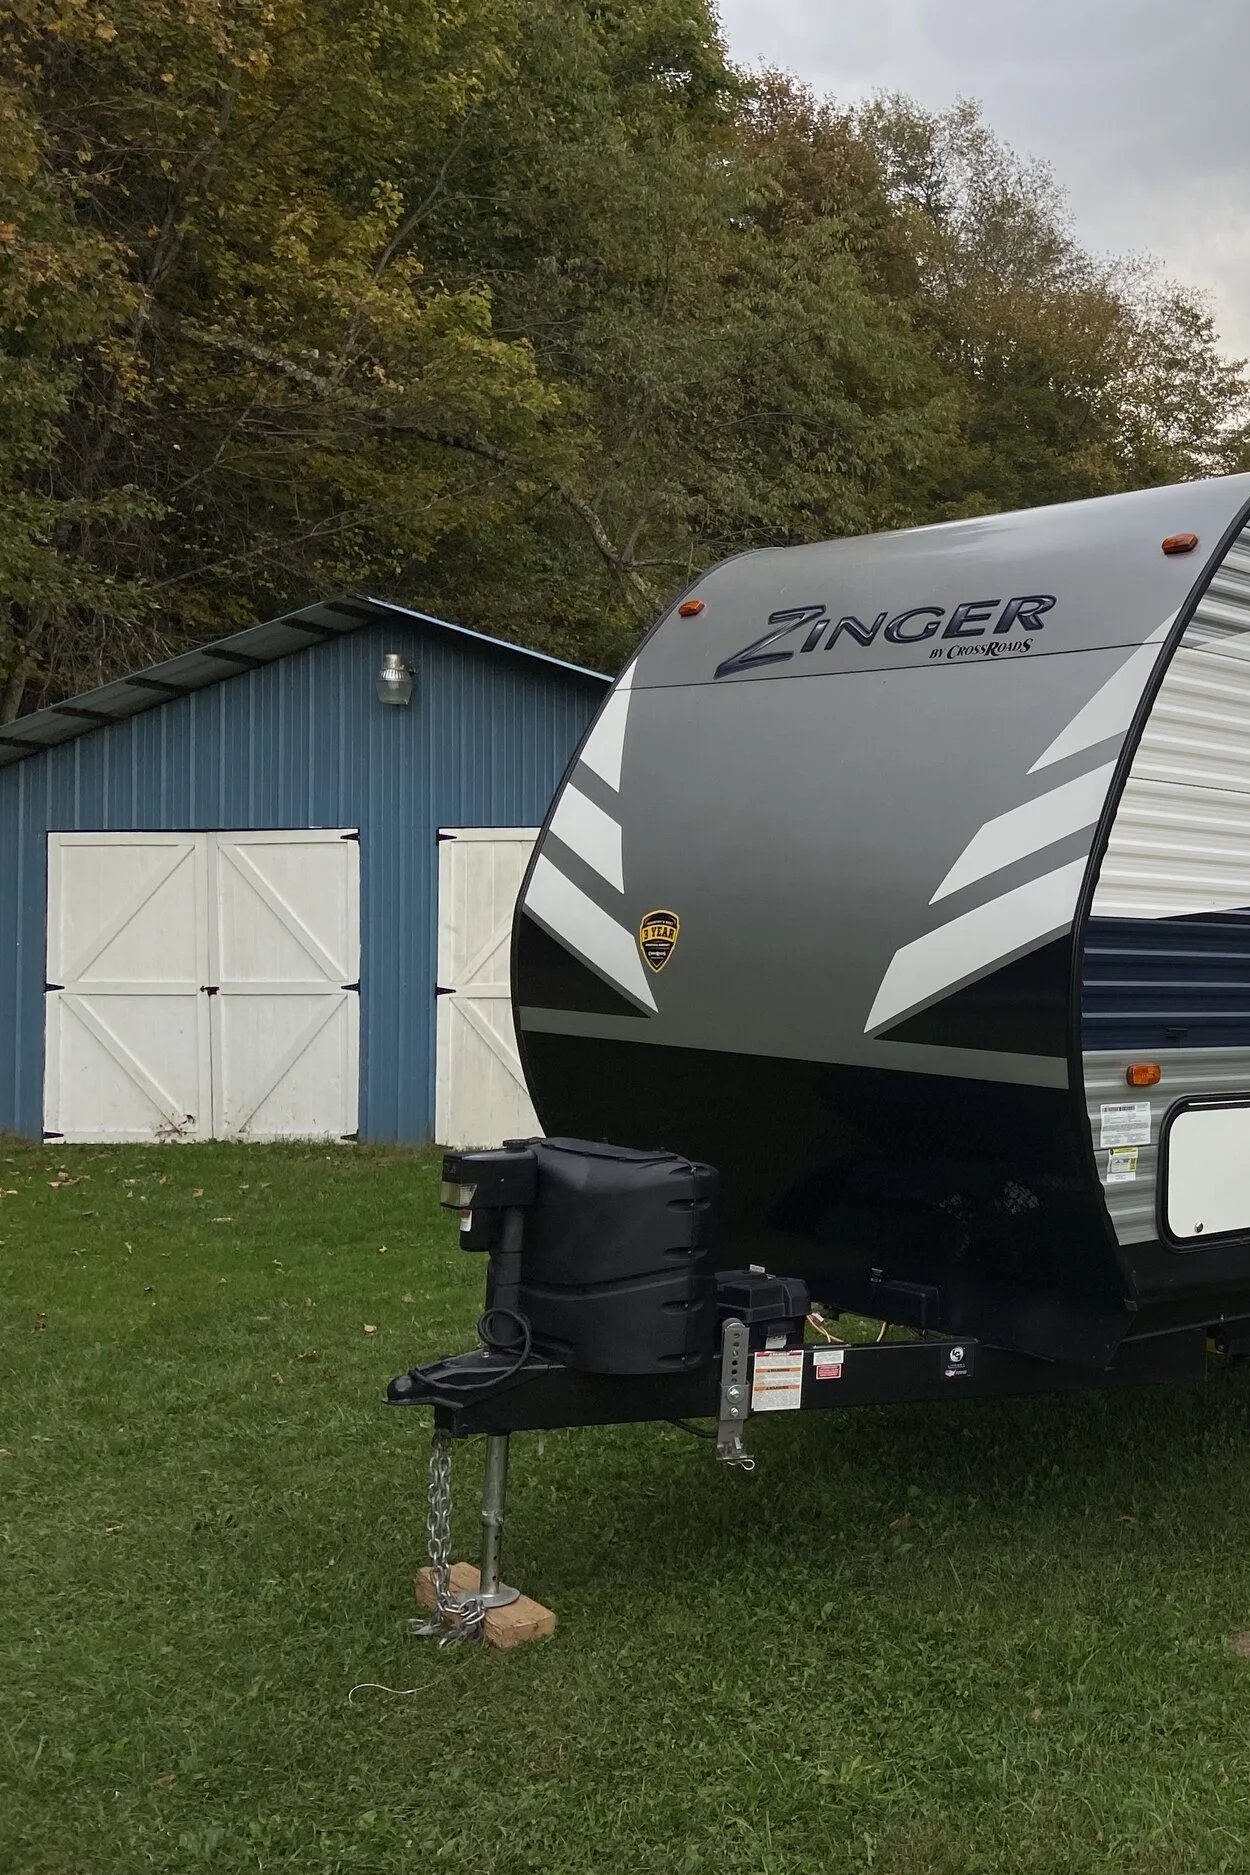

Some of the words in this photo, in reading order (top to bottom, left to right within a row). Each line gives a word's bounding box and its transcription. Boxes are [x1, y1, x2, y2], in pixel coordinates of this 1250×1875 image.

[713, 595, 1057, 680] ZINGER
[929, 648, 944, 659] BY
[643, 929, 649, 940] 3
[651, 926, 675, 940] YEAR
